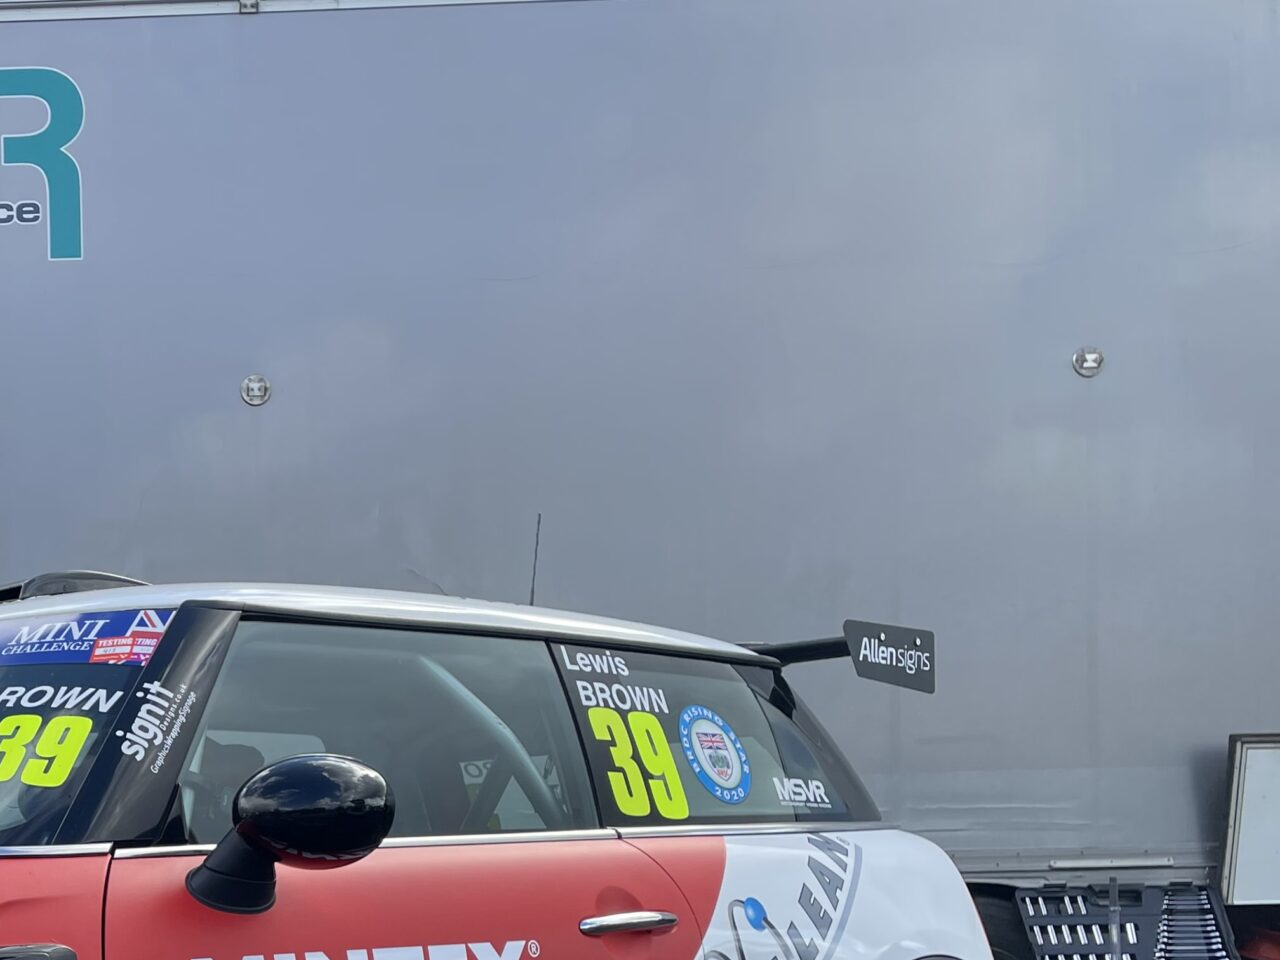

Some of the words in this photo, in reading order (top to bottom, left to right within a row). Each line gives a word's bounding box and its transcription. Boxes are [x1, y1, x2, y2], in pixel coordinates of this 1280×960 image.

[8, 619, 110, 646] MINI
[98, 637, 133, 647] TESTING
[1, 641, 93, 656] CHALLENGE
[560, 645, 630, 677] Lewis
[576, 680, 670, 714] BROWN
[683, 705, 724, 726] RISING
[587, 706, 690, 820] 39
[715, 787, 745, 800] 2020
[772, 777, 830, 803] MSVR
